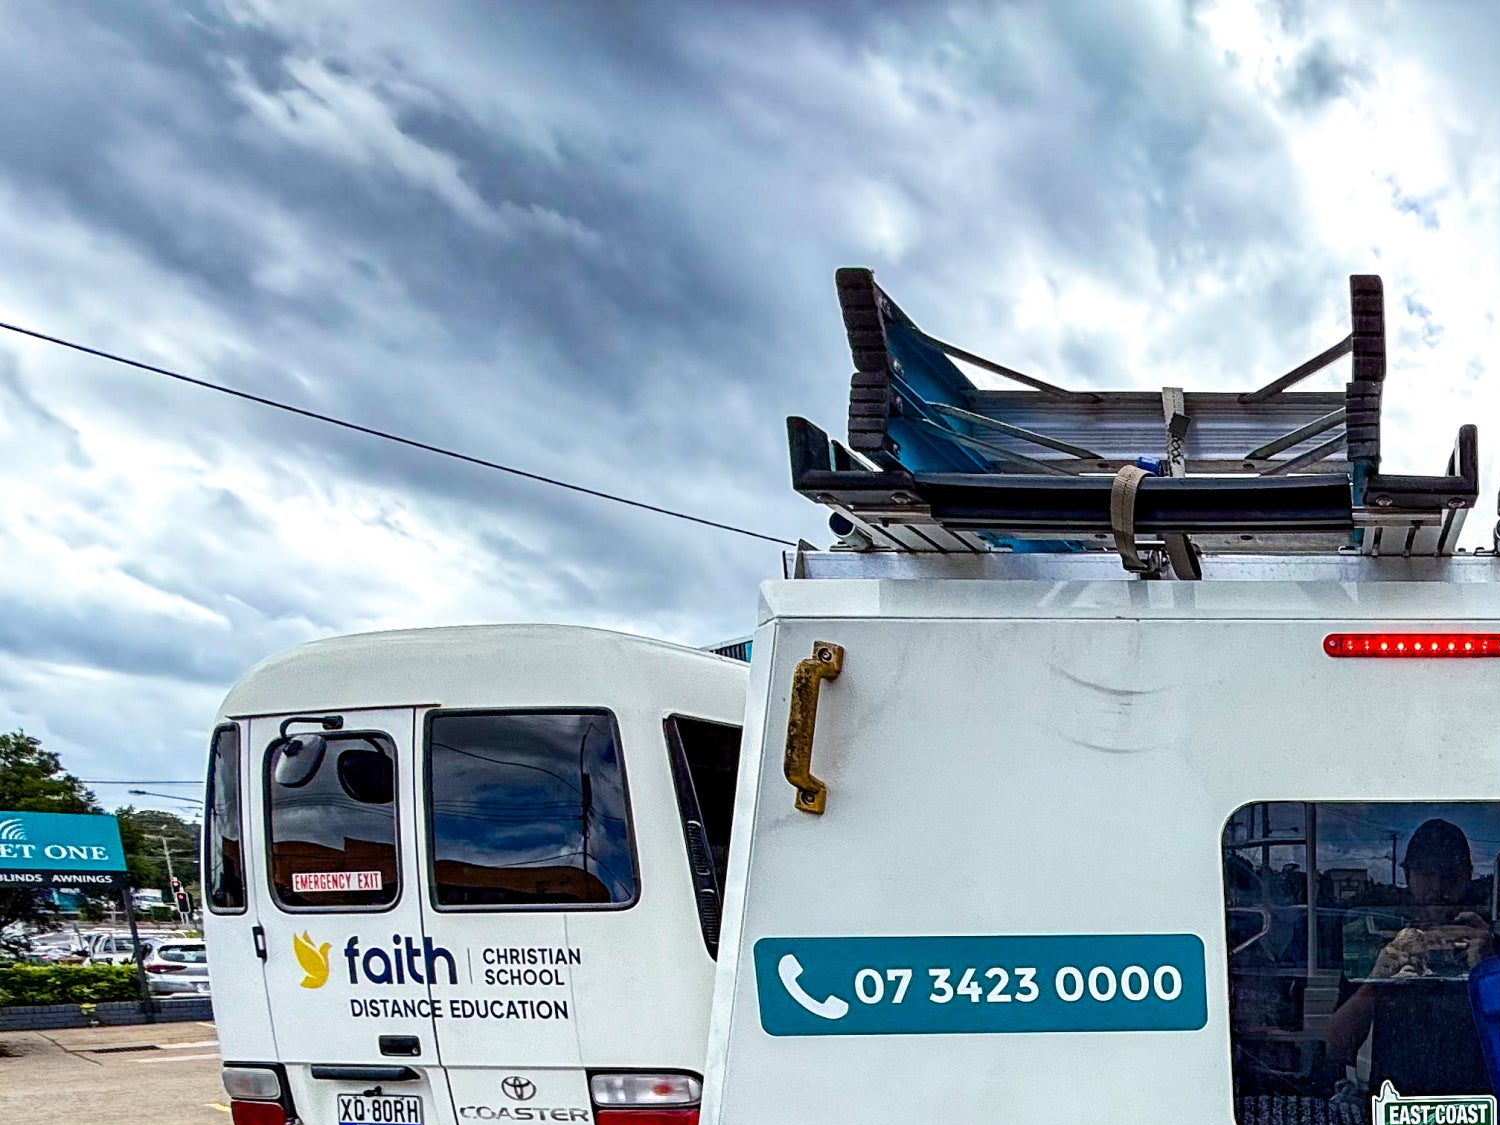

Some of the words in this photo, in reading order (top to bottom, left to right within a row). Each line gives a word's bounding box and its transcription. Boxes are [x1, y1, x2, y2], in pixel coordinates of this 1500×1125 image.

[44, 845, 109, 861] ONE
[52, 874, 113, 884] AWNINGS
[295, 872, 351, 890] EMERGENCY
[358, 871, 380, 889] EXIT
[344, 934, 458, 985] faith
[482, 948, 582, 966] CHRISTIAN
[484, 969, 565, 986] SCHOOL
[854, 968, 913, 1004] 07
[928, 967, 1040, 1003] 3423
[1055, 965, 1183, 1002] 0000
[350, 999, 443, 1018] DISTANCE
[450, 1000, 569, 1020] EDUCATION
[459, 1105, 590, 1123] COASTER
[1389, 1105, 1432, 1125] EAST
[1435, 1104, 1488, 1124] COAST
